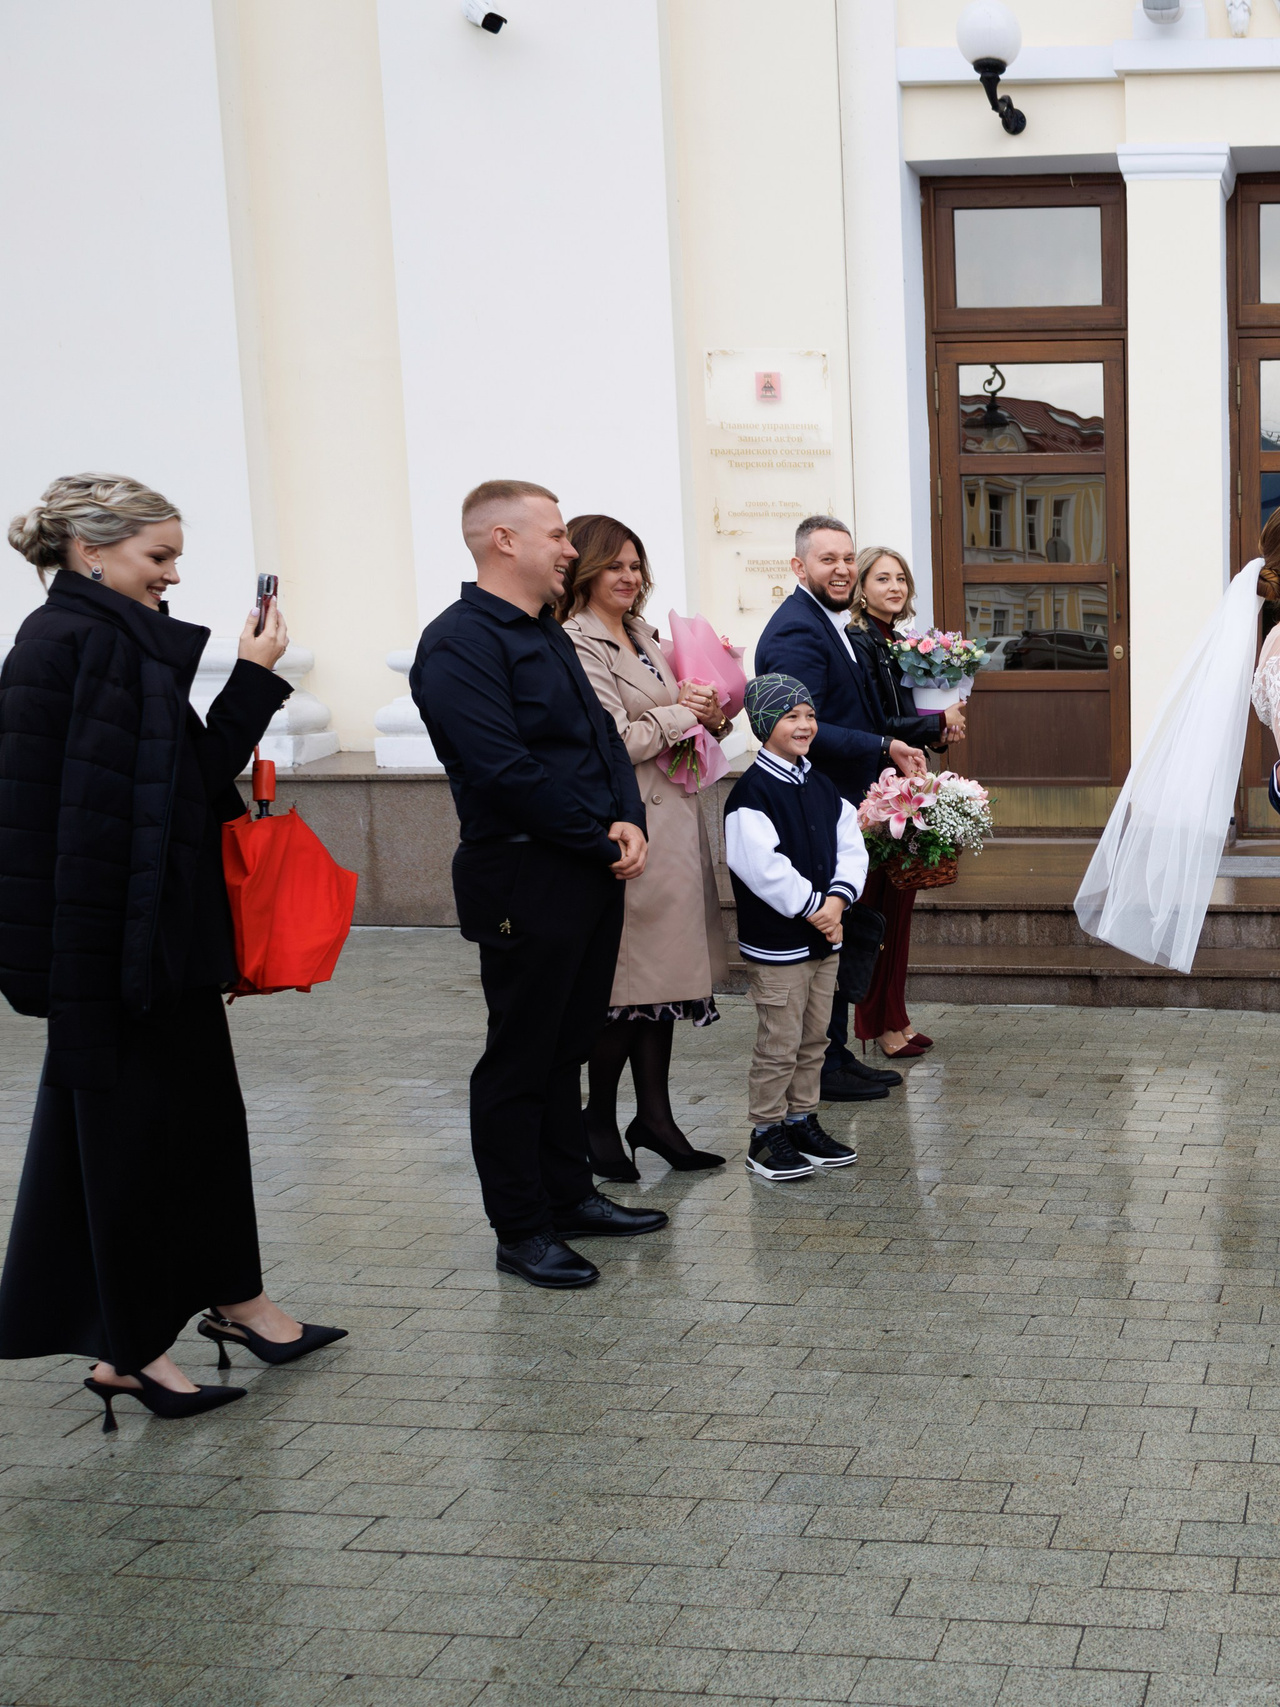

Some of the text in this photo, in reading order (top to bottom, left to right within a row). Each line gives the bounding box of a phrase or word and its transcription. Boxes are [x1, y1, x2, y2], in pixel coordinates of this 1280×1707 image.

[720, 421, 819, 431] Главное управление
[774, 434, 803, 442] актов
[710, 447, 831, 456] гражданского состояния
[728, 459, 814, 469] Тверской области
